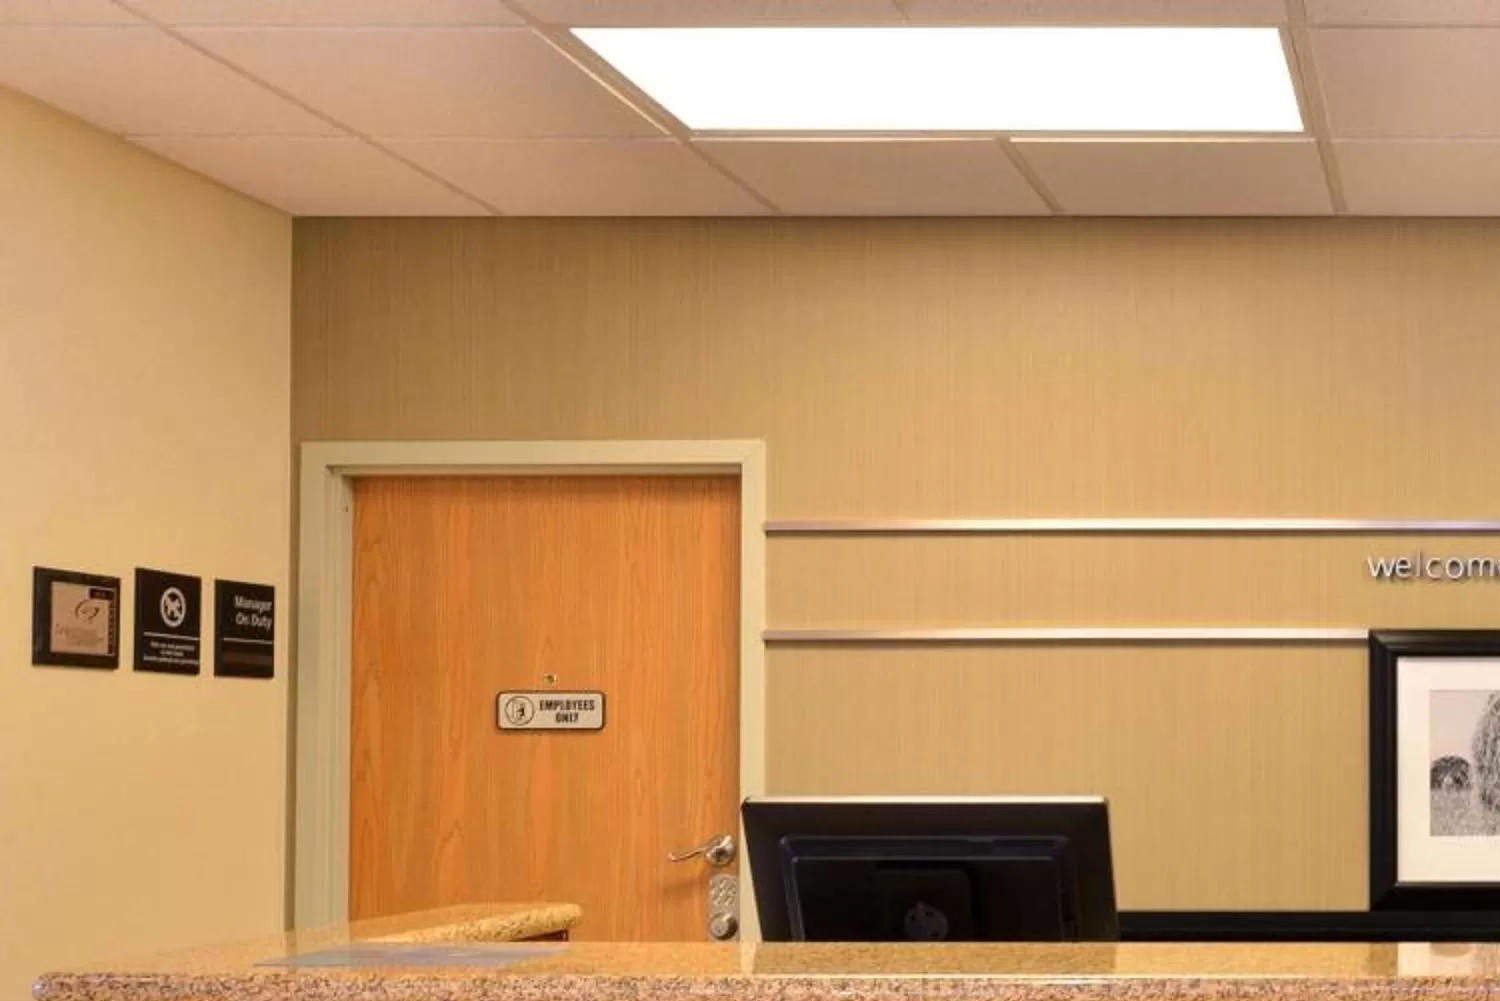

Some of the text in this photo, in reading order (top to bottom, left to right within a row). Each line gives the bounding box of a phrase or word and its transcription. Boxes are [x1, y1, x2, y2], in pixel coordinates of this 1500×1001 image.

[234, 595, 273, 615] Manager
[235, 611, 273, 632] On Duty
[540, 699, 595, 711] EMPLOYEES
[555, 712, 579, 723] ONLY
